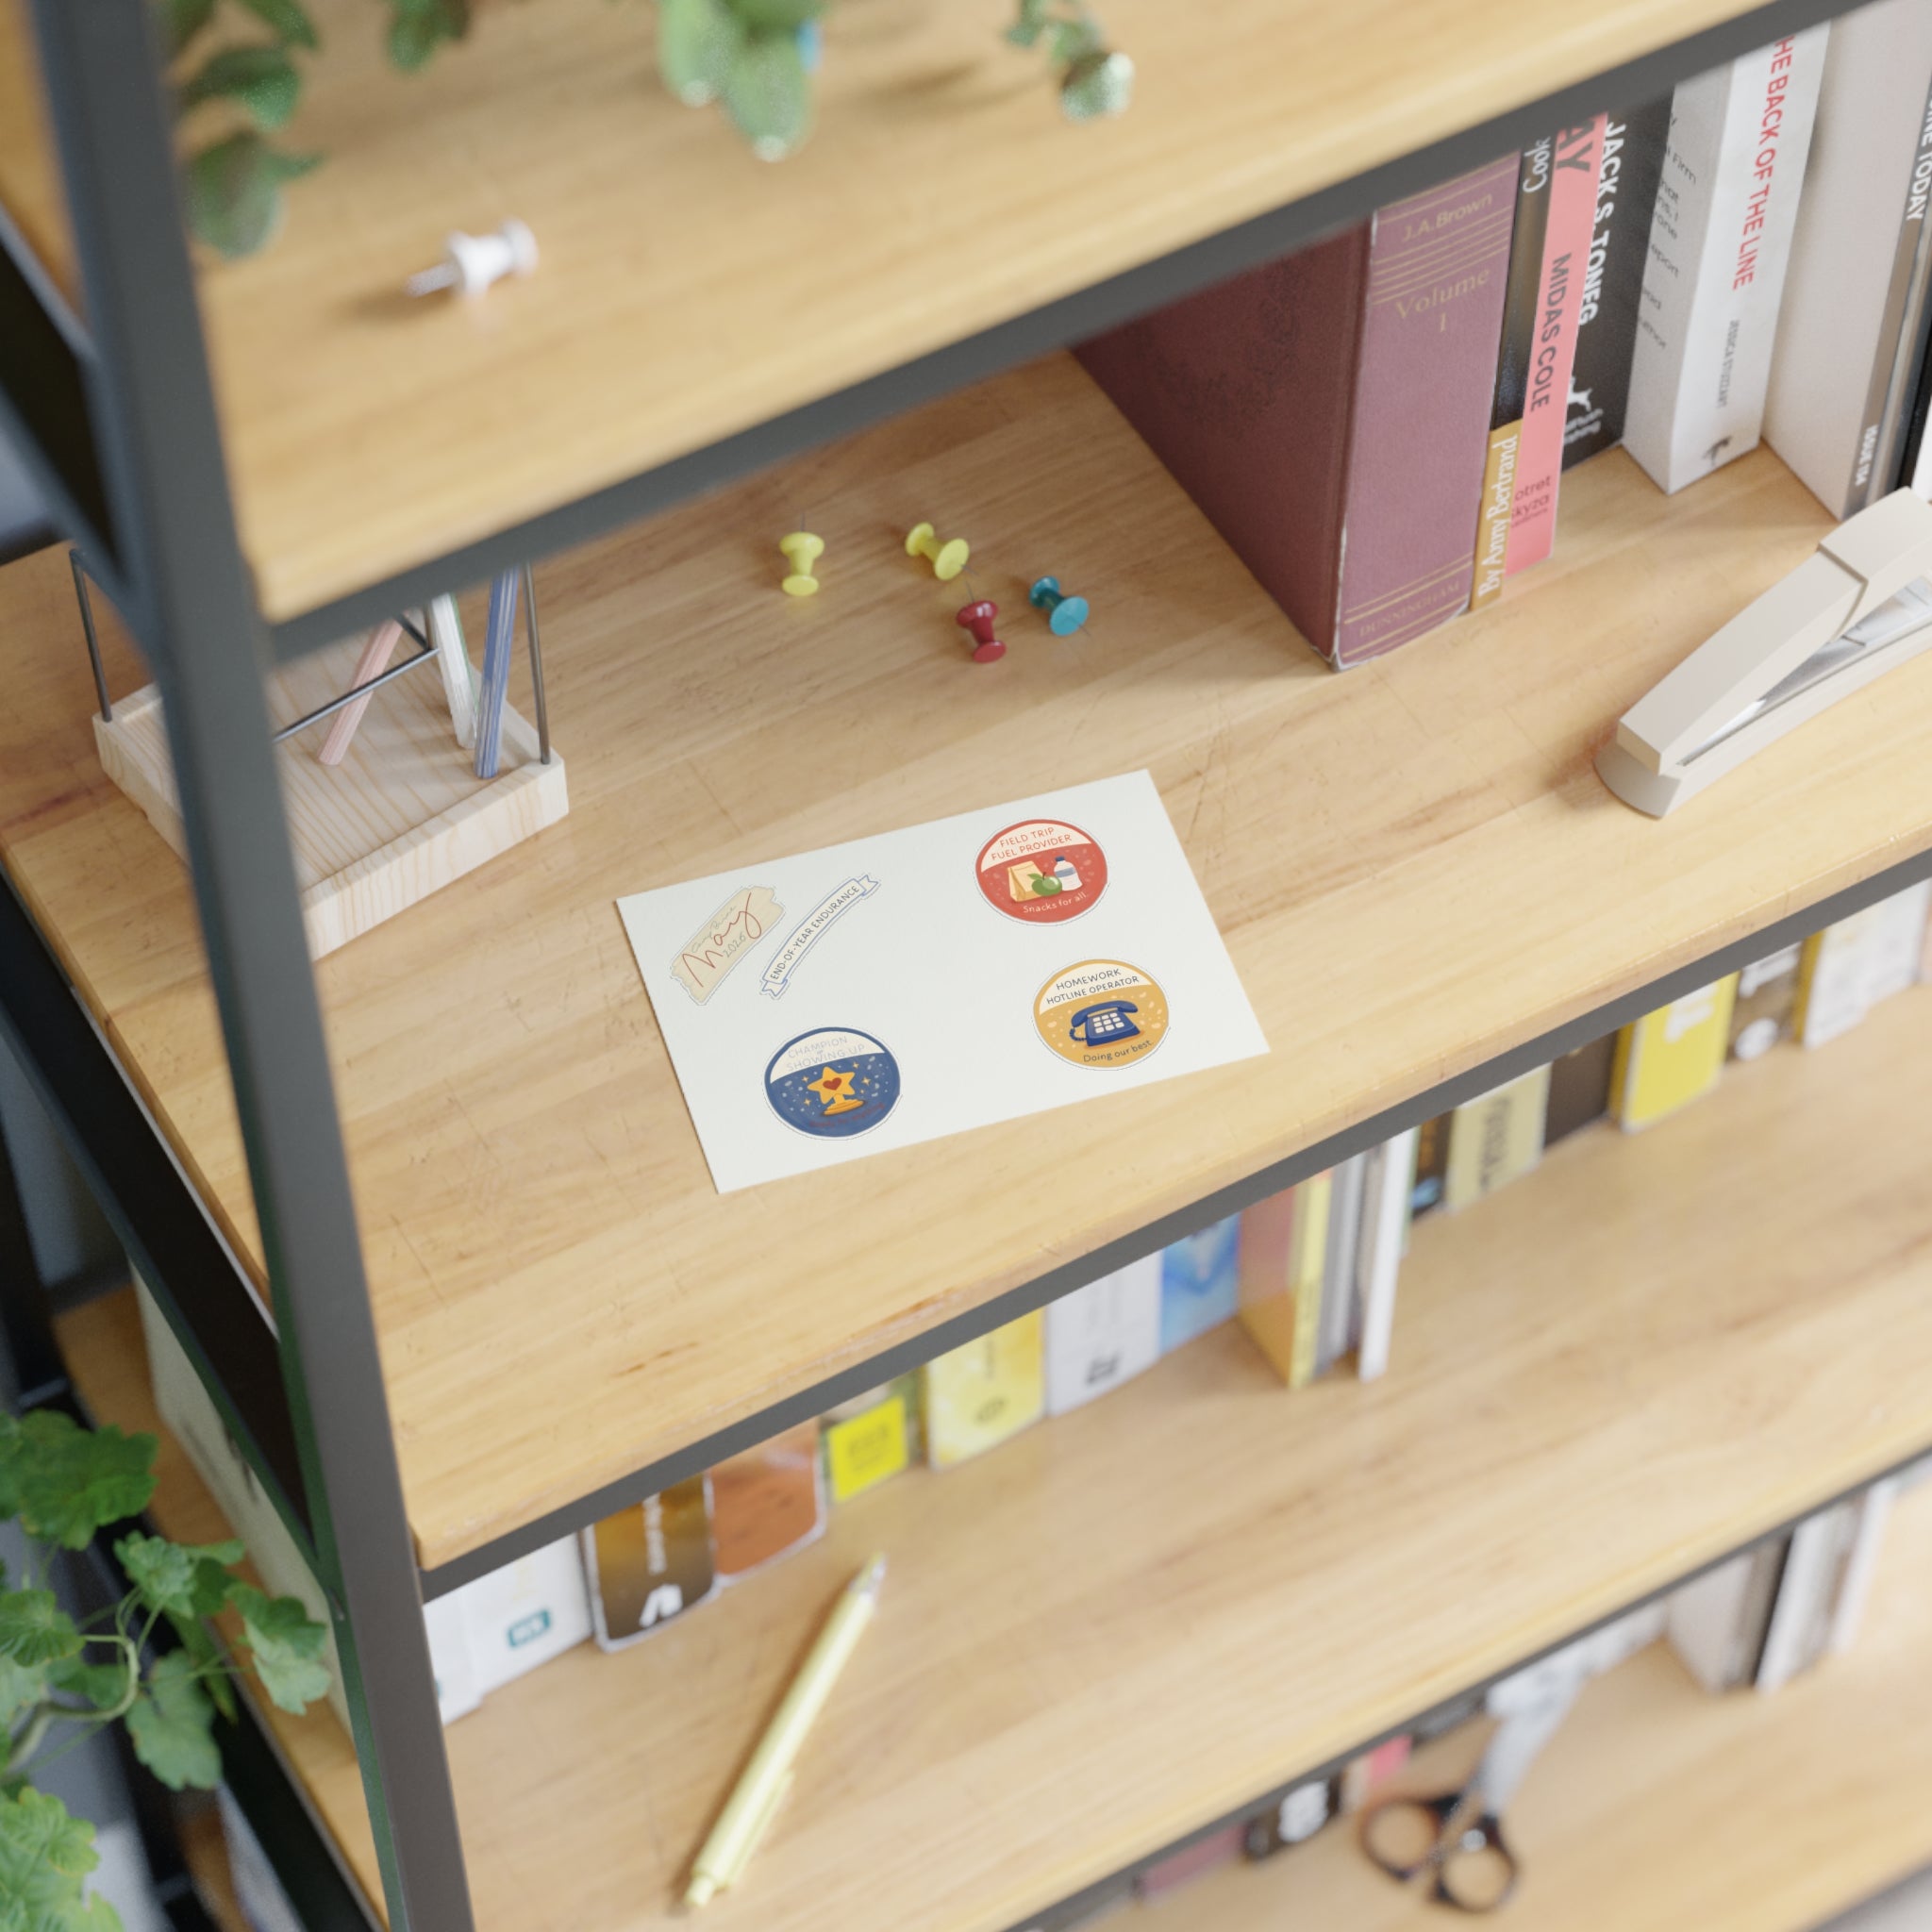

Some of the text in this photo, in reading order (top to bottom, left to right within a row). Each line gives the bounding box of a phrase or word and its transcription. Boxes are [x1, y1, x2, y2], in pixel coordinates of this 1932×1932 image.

[1758, 74, 1789, 145] BACK
[1522, 136, 1551, 192] Cook
[1596, 121, 1627, 201] JACK
[1753, 147, 1776, 181] OF
[1906, 149, 1932, 220] TODAY
[1742, 183, 1771, 237] THE
[1732, 235, 1761, 291] LINE
[1393, 269, 1491, 319] Volume
[1530, 252, 1572, 413] MIDAS COLE
[1486, 434, 1518, 521] Bertrand
[1477, 568, 1505, 599] By
[991, 834, 1073, 861] FUEL PROVIDER
[999, 827, 1055, 848] FIELD TRIP
[1023, 902, 1057, 913] Snacks
[1058, 898, 1073, 908] for
[681, 891, 762, 988] May
[723, 931, 747, 958] 2026
[770, 885, 860, 980] END-OF-YEAR ENDURANCE
[1046, 975, 1140, 1005] HOTLINE OPERATOR
[1056, 968, 1122, 991] HOMEWORK
[786, 1043, 865, 1072] SHOWING UP
[788, 1036, 848, 1058] CHAMPION
[1083, 1053, 1113, 1062] Doing
[1114, 1048, 1130, 1058] our
